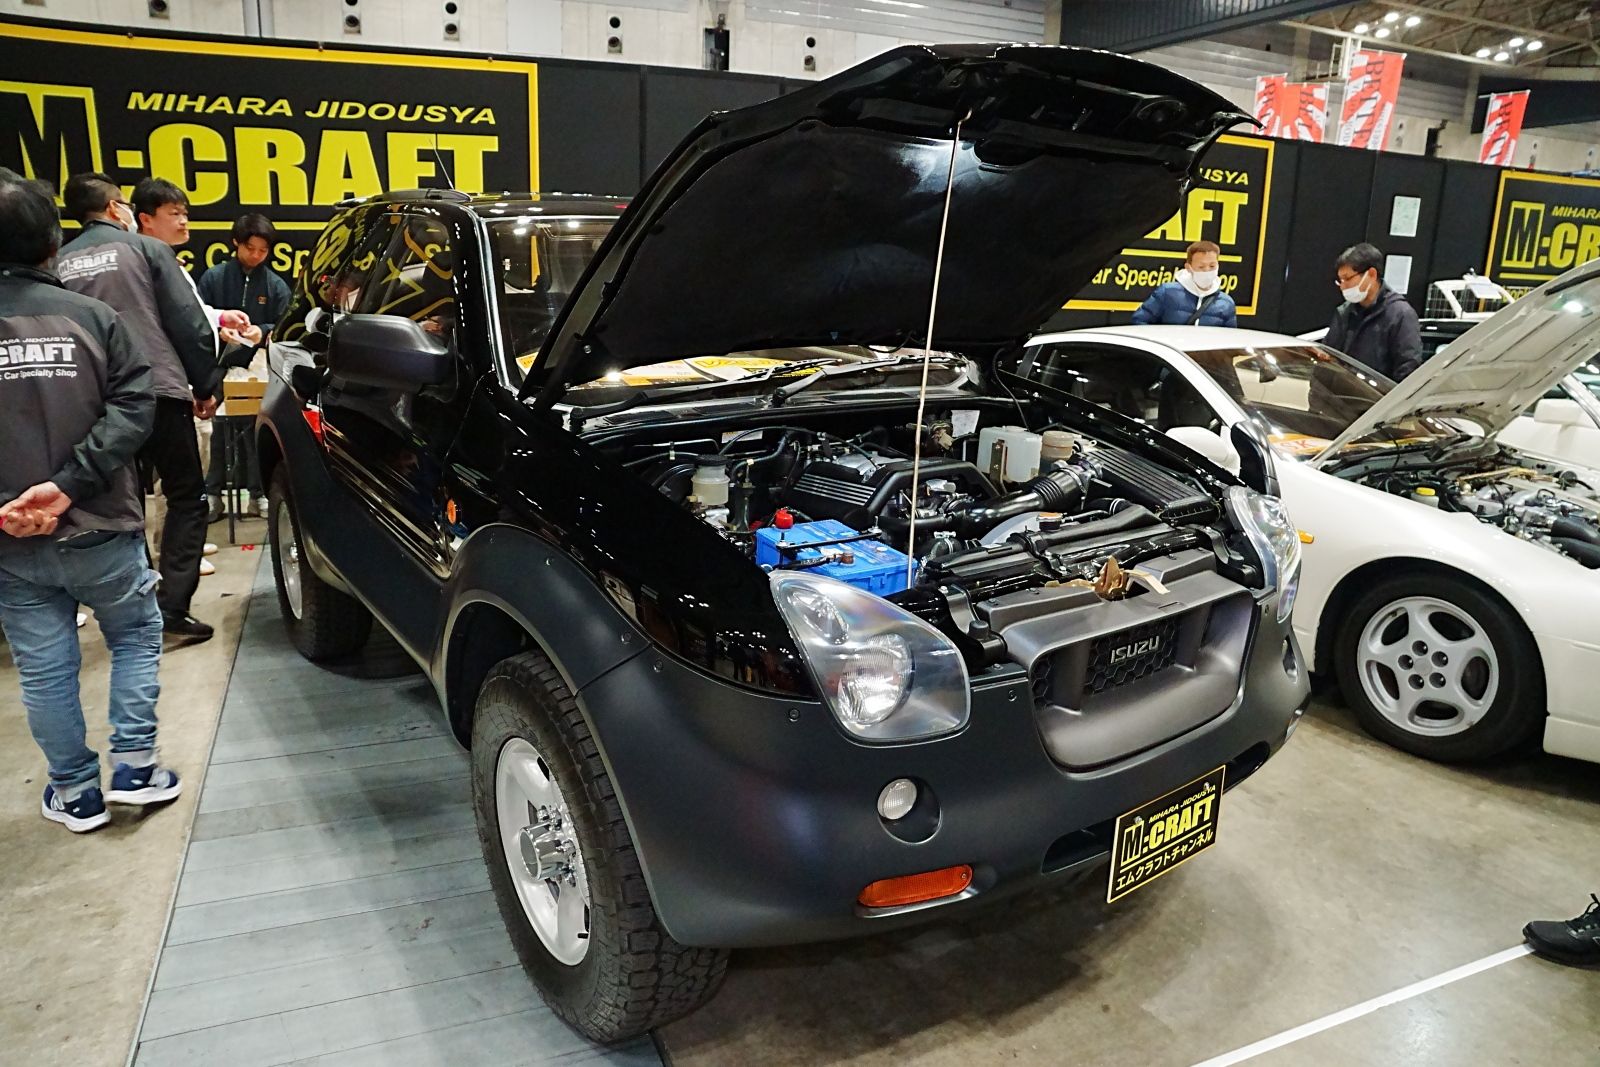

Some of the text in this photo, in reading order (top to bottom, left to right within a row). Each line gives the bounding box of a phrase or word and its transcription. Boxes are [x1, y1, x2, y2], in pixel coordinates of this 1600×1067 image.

[127, 91, 497, 125] MIHARA JIDOUSYA
[4, 371, 19, 380] Car
[55, 368, 78, 378] Shop
[1110, 635, 1160, 664] ISUZU
[1148, 803, 1179, 824] MIHARA
[1115, 828, 1214, 892] エムクラフトチャンネル
